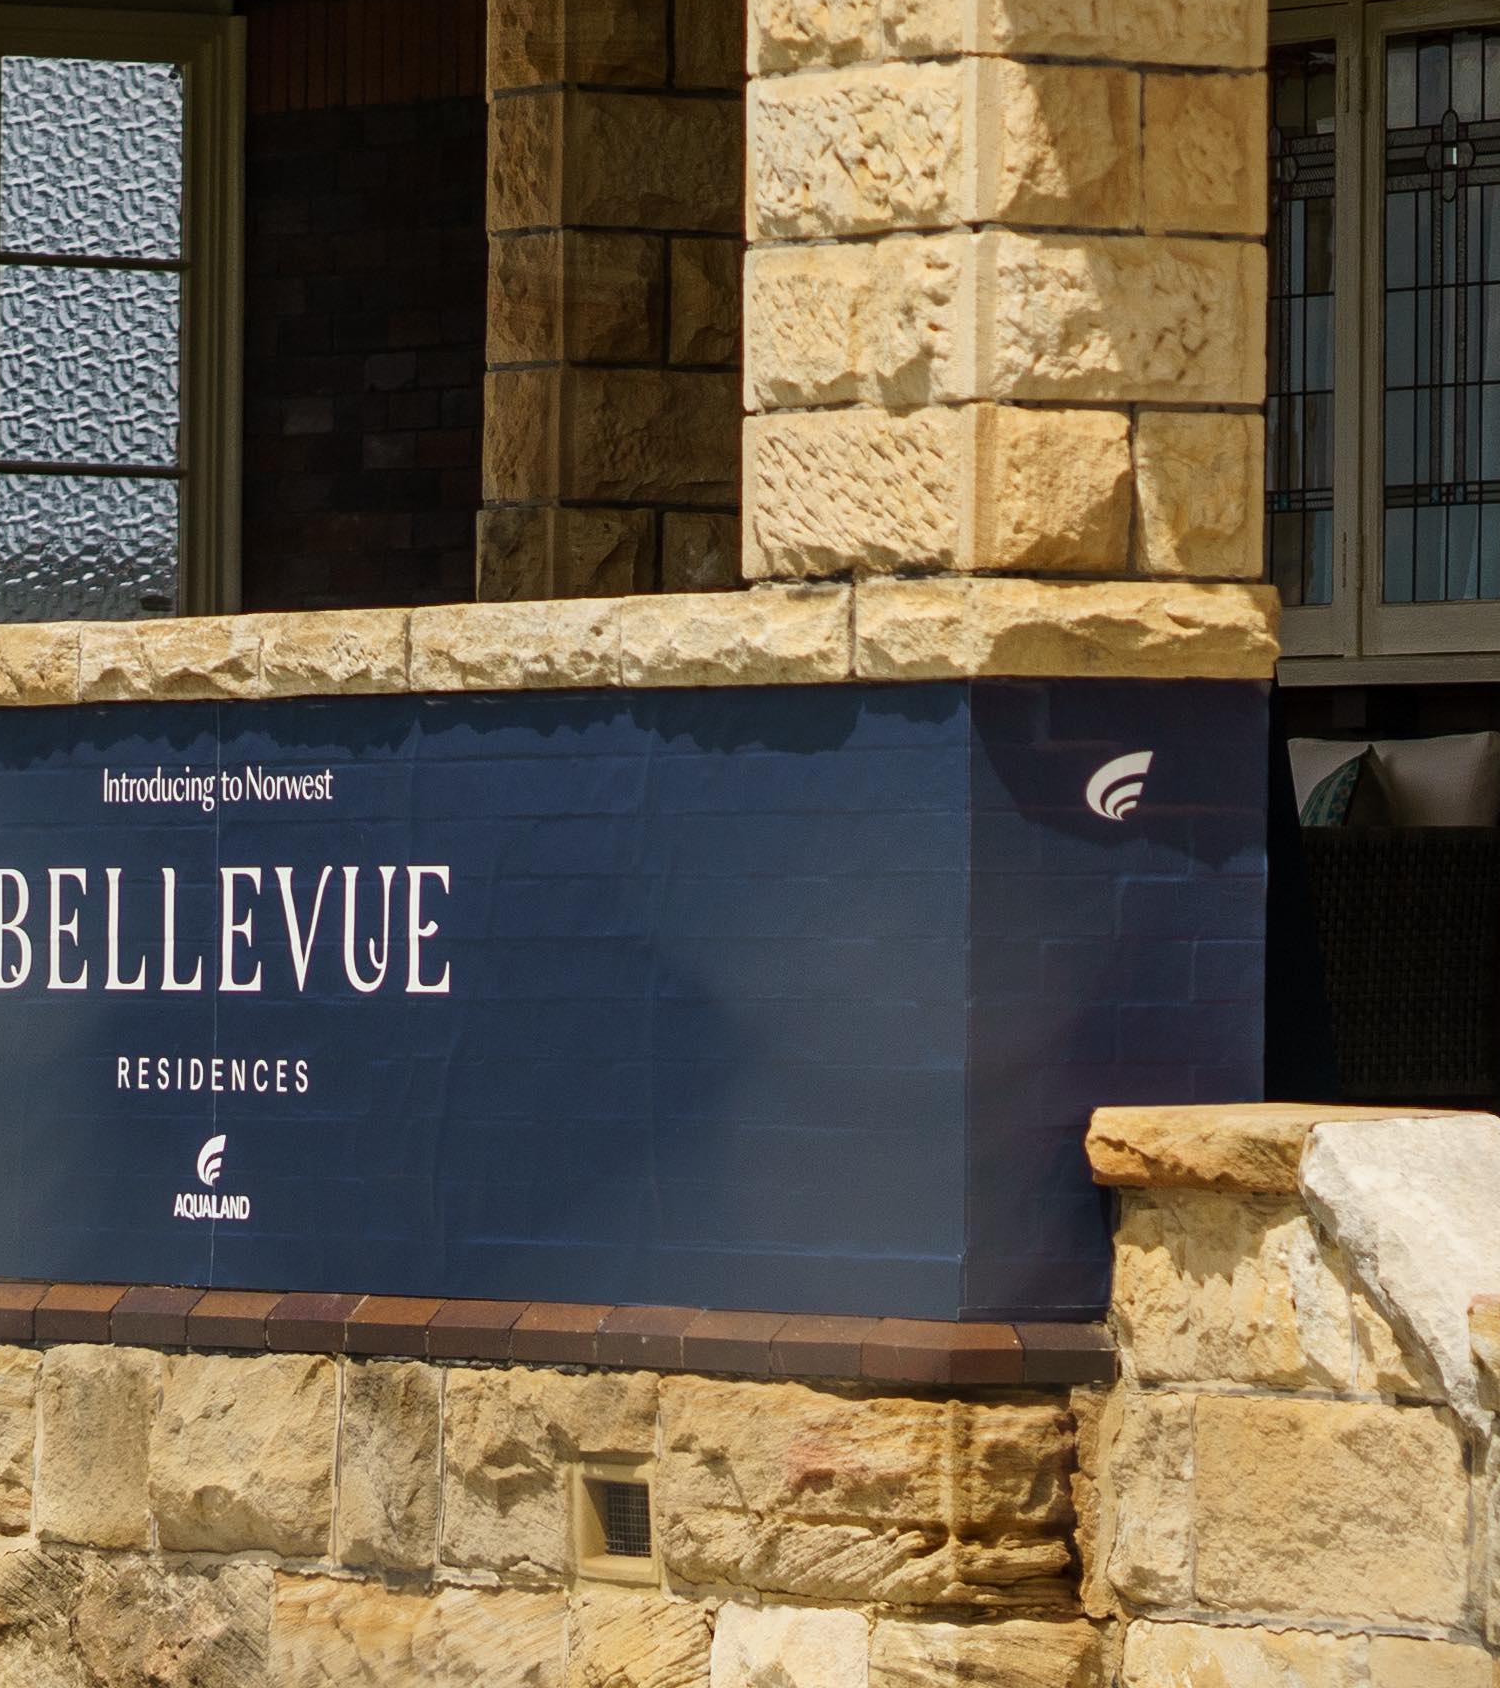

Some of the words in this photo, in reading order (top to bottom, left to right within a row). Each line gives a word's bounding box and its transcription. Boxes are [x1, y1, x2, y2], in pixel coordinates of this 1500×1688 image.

[103, 765, 216, 812] Introducing
[220, 771, 243, 802] to
[246, 765, 334, 801] Norwest
[117, 1056, 309, 1093] RESIDENCES
[173, 1192, 250, 1221] AQUALAND
